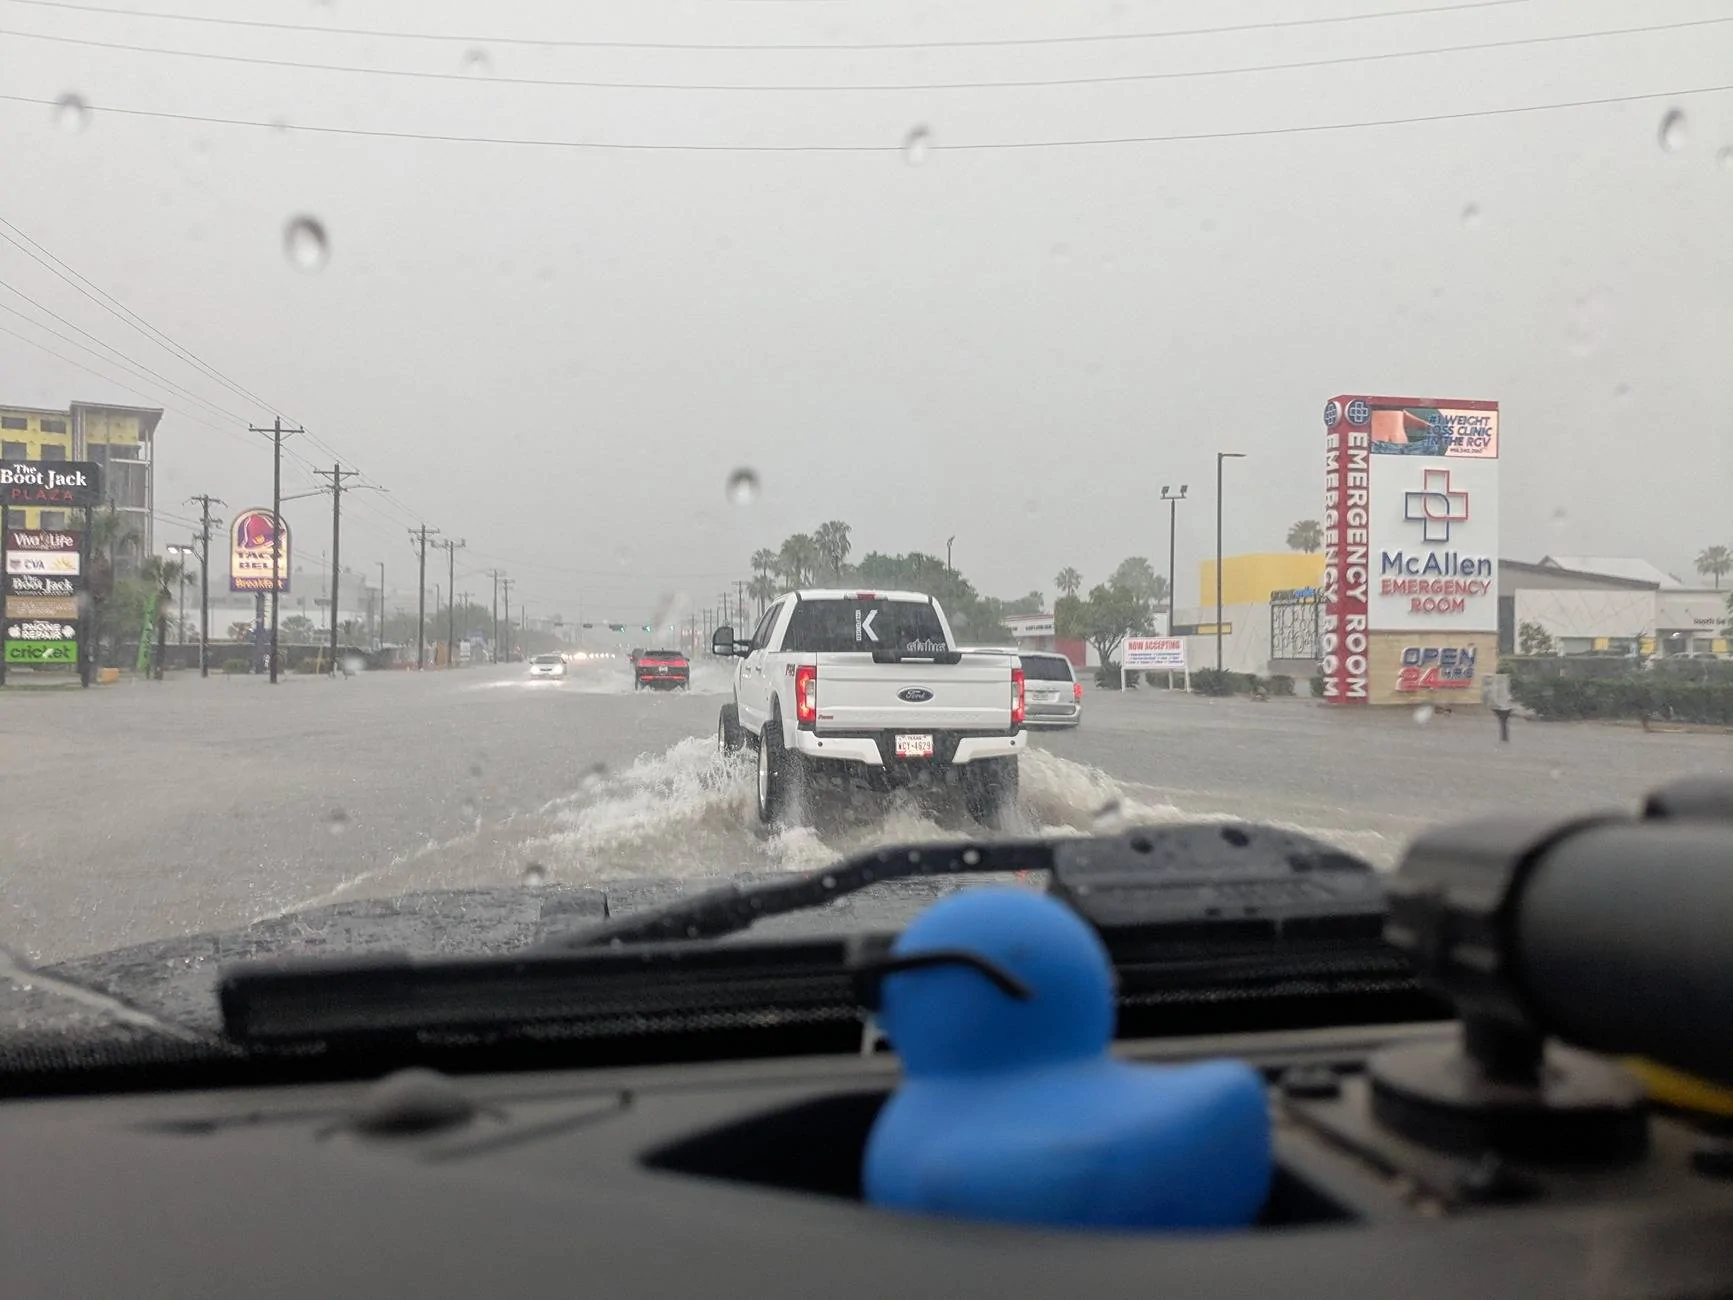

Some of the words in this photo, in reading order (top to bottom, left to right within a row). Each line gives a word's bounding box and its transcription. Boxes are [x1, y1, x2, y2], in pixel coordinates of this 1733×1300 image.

[1444, 415, 1491, 426] WEIGHT
[1457, 426, 1493, 437] CLINIC
[1443, 436, 1464, 446] THE
[1467, 437, 1492, 448] RGV
[13, 463, 37, 475] The
[0, 468, 43, 486] Boot
[44, 470, 87, 490] Jack
[11, 487, 75, 501] PLAZA
[1324, 432, 1340, 604] EMERGENCY
[1346, 431, 1368, 603] EMERGENCY
[23, 559, 46, 570] CVA
[1381, 551, 1492, 576] McAllen
[235, 577, 283, 589] Breakfat
[1380, 579, 1492, 596] EMERGENCY
[1409, 598, 1465, 613] ROOM
[1322, 614, 1340, 697] ROOM
[1345, 614, 1367, 698] ROOM
[1401, 646, 1477, 667] OPEN
[1396, 666, 1446, 692] 24
[905, 689, 926, 699] Ford
